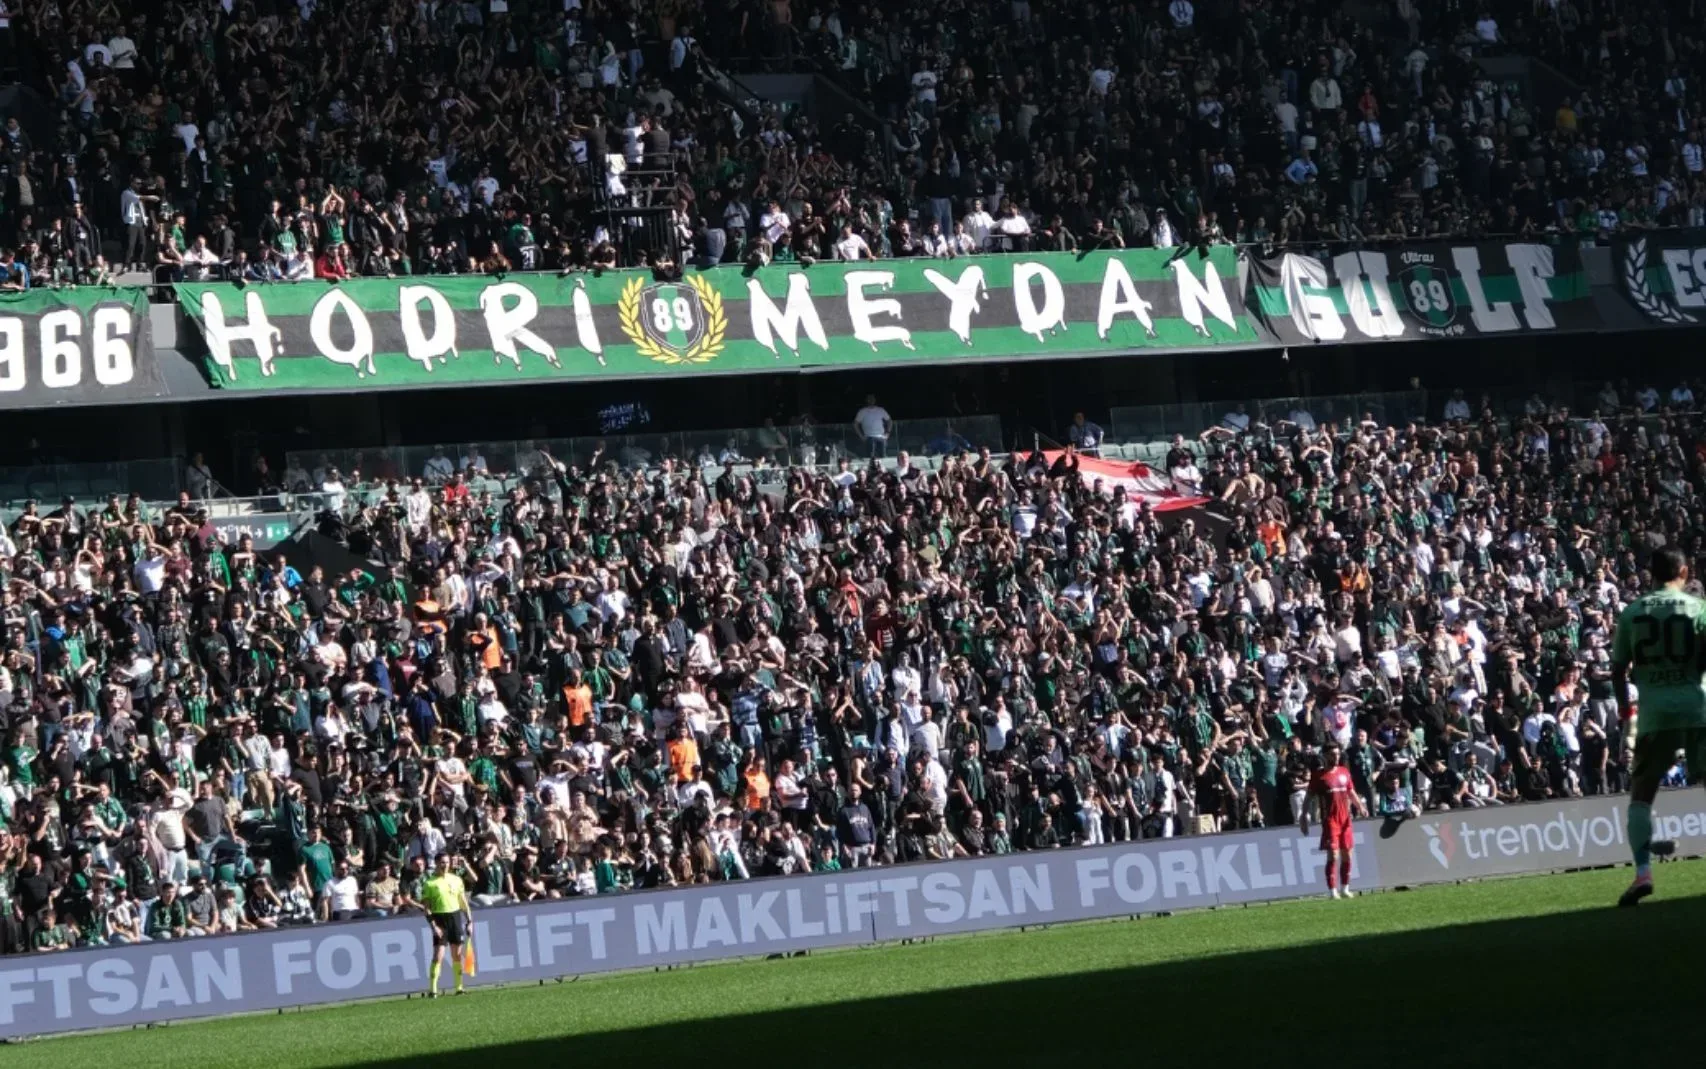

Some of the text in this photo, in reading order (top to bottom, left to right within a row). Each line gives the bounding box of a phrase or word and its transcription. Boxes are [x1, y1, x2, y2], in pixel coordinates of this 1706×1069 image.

[651, 293, 693, 332] 89
[746, 257, 1239, 358] MEYDAN
[1410, 280, 1449, 313] 89
[1632, 614, 1696, 665] 20
[1459, 806, 1624, 858] trendyol
